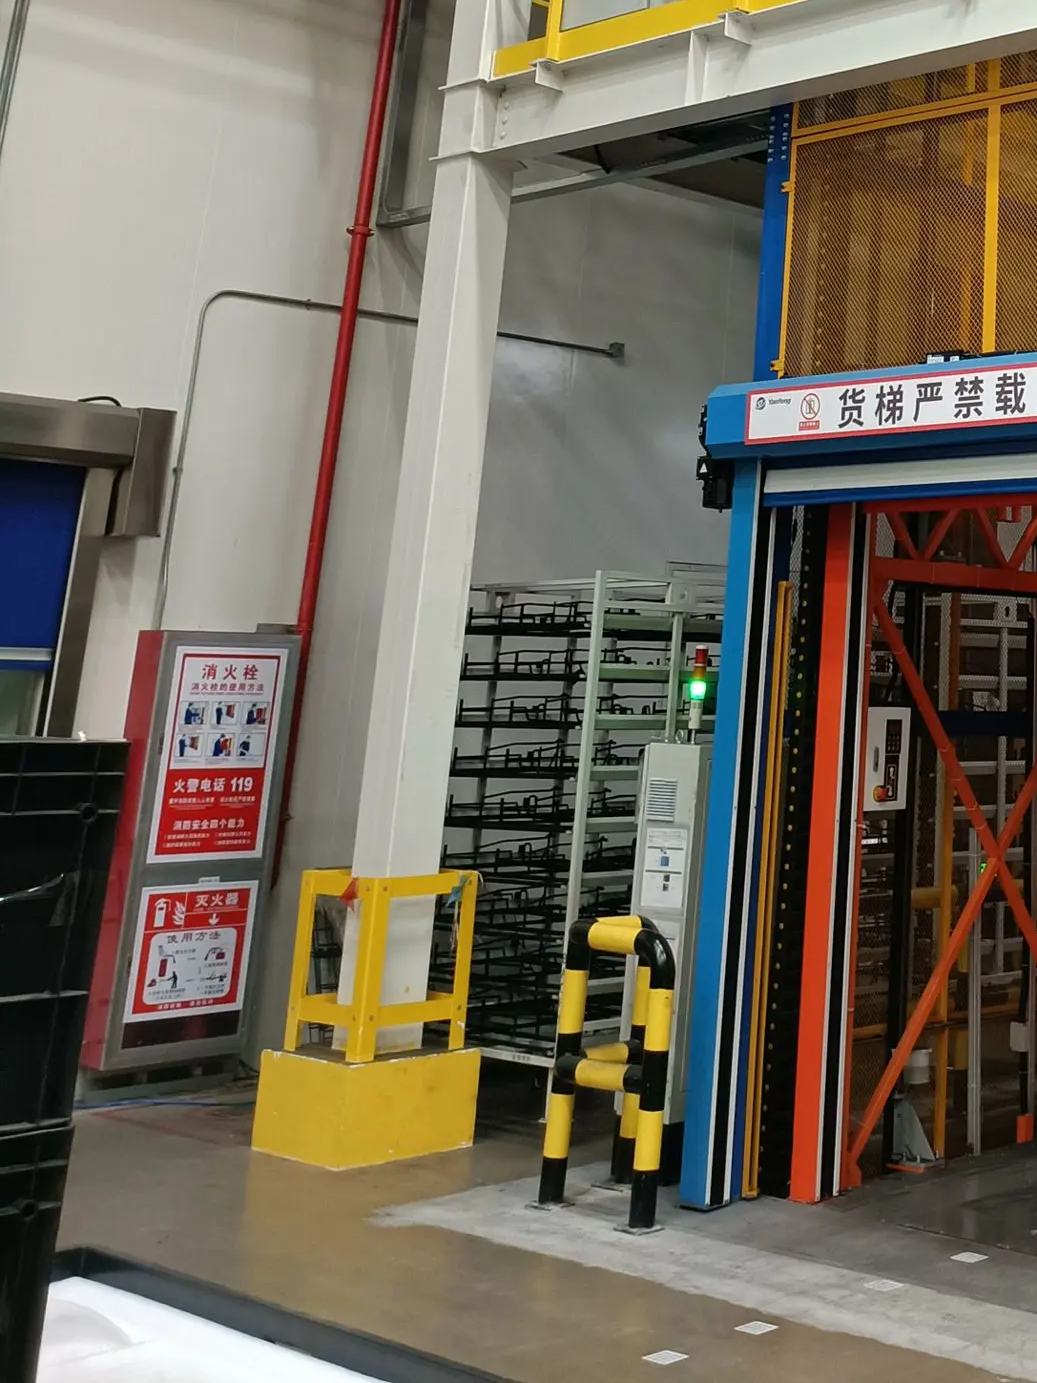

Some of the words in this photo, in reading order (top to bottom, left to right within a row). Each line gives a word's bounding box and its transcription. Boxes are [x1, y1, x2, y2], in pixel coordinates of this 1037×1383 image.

[202, 664, 259, 680] 消火栓
[173, 777, 226, 793] 火警电话
[230, 776, 253, 792] 119
[195, 892, 239, 907] 灭火器
